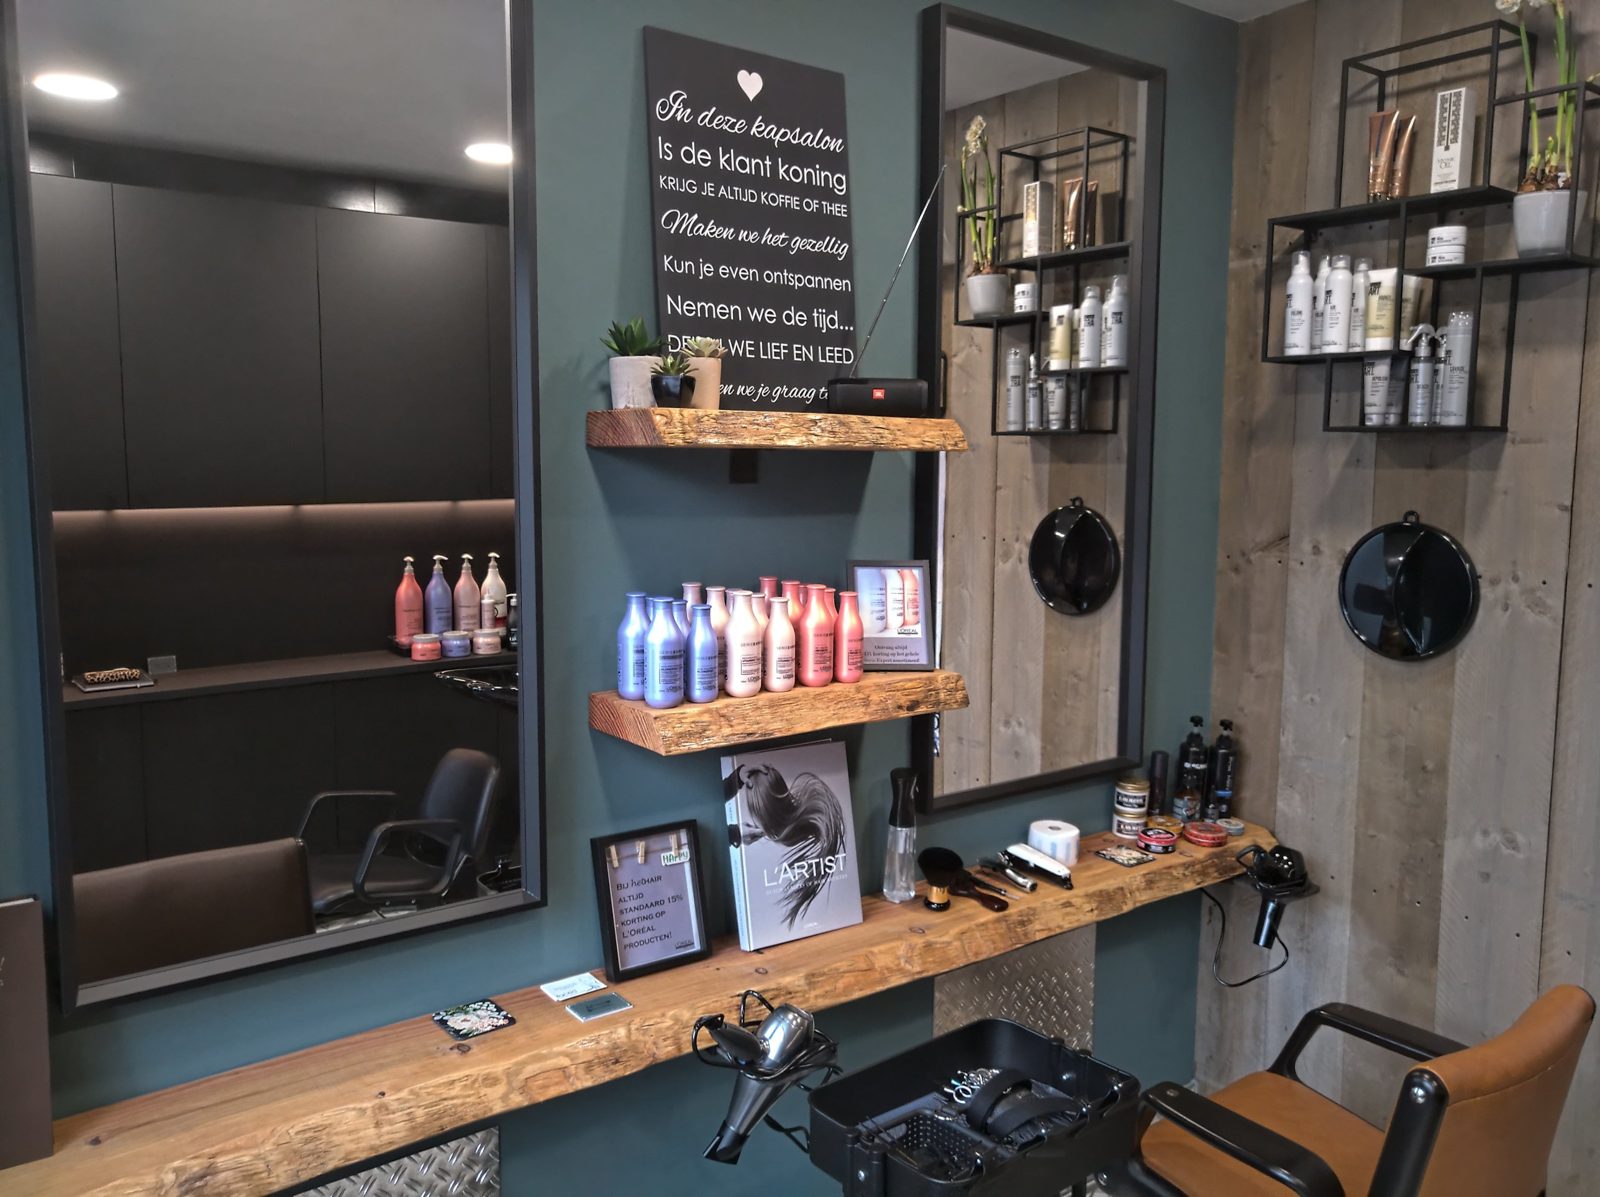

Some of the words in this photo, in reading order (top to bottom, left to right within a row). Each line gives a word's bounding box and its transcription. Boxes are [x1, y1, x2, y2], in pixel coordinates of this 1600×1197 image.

[656, 90, 693, 122] In
[697, 106, 748, 134] deze
[750, 115, 845, 153] kapsalon
[658, 136, 673, 161] Is
[680, 141, 712, 167] de
[718, 146, 772, 178] klant
[778, 157, 847, 195] koning
[659, 174, 698, 194] KRIJG
[701, 182, 715, 197] JE
[718, 185, 758, 203] ALTIJD
[760, 191, 801, 210] KOFFIE
[802, 198, 820, 213] OF
[821, 201, 848, 218] THEE
[661, 209, 736, 241] Maken
[738, 229, 760, 244] we
[761, 227, 790, 248] het
[790, 236, 850, 261] gezellig
[663, 254, 695, 275] Kun
[698, 258, 714, 280] je
[718, 264, 759, 282] even
[763, 268, 852, 292] ontspannen
[666, 294, 742, 321] Nemen
[747, 305, 777, 324] we
[782, 306, 808, 327] de
[812, 307, 854, 333] tijd...
[728, 338, 755, 358] WE
[759, 341, 789, 361] LIEF
[793, 344, 814, 362] EN
[818, 346, 854, 364] LEED
[736, 384, 756, 396] we
[753, 383, 770, 401] je
[771, 384, 816, 404] graag
[763, 853, 847, 887] L'ARTIST
[616, 883, 629, 891] BIJ
[618, 892, 644, 904] ALTIJD
[619, 899, 665, 916] STANDAARD
[667, 894, 684, 905] 15%
[621, 914, 654, 927] KORTING
[655, 910, 666, 918] OP
[623, 931, 672, 950] PRODUCTEN!
